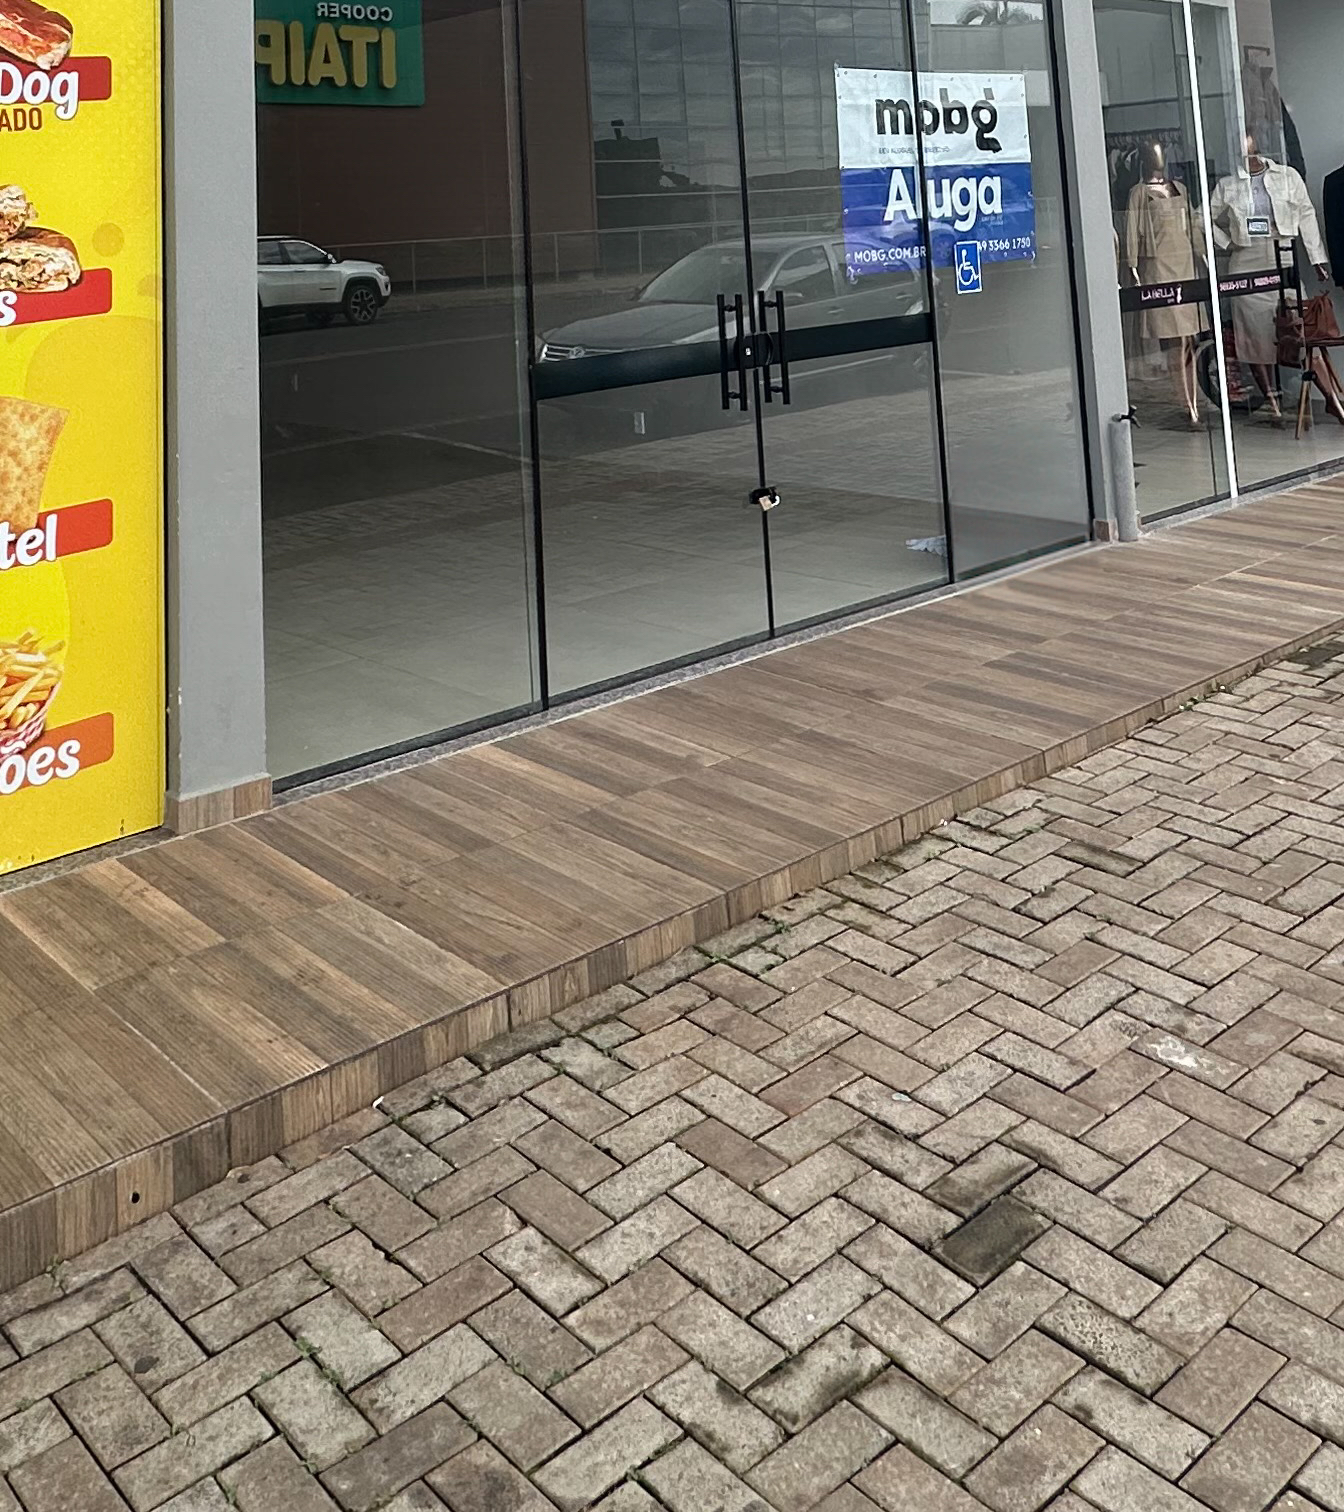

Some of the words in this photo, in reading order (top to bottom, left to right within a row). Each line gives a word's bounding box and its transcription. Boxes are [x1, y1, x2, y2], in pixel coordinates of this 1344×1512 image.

[874, 88, 1002, 154] mobg
[883, 166, 1003, 232] Aluga
[854, 245, 927, 263] MOBG.COM.BR
[988, 238, 1010, 251] 3366
[1012, 236, 1031, 249] 1750
